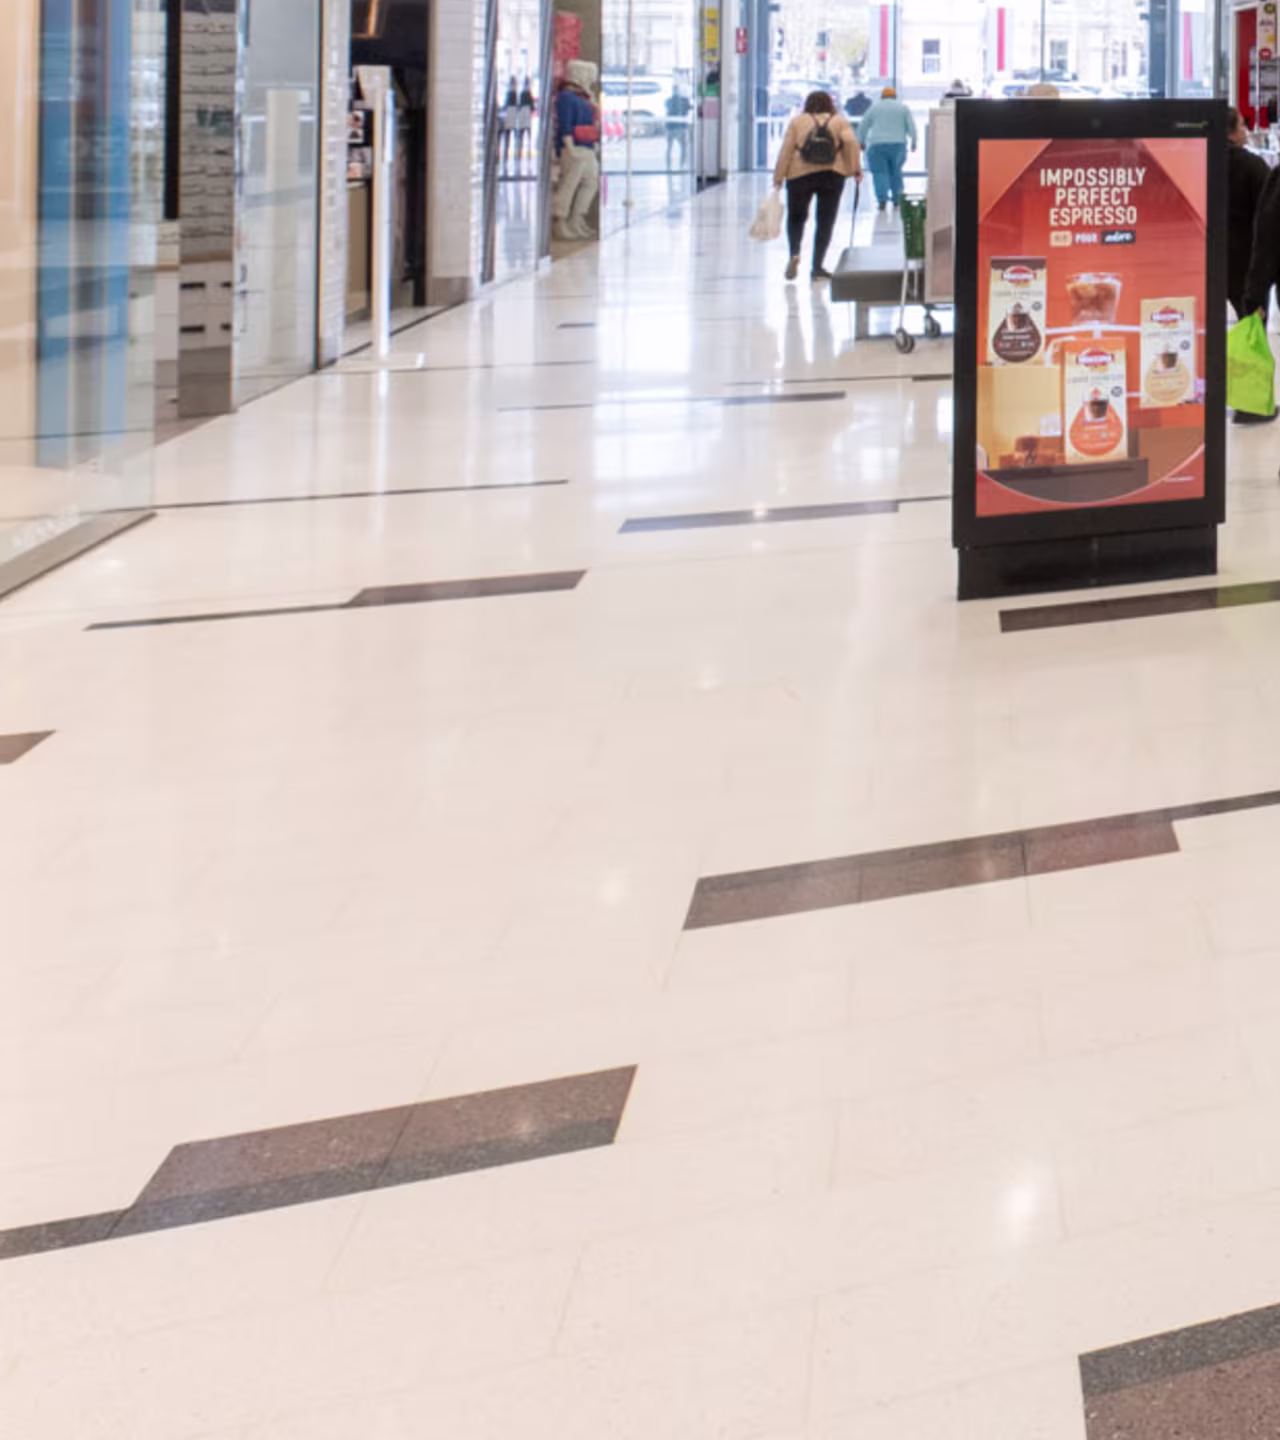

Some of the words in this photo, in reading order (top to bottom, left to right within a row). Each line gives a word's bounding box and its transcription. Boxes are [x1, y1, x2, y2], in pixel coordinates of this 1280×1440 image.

[1040, 167, 1146, 187] IMPOSSIBLY
[1055, 187, 1131, 207] PERFECT
[1049, 206, 1138, 226] ESPRESSO
